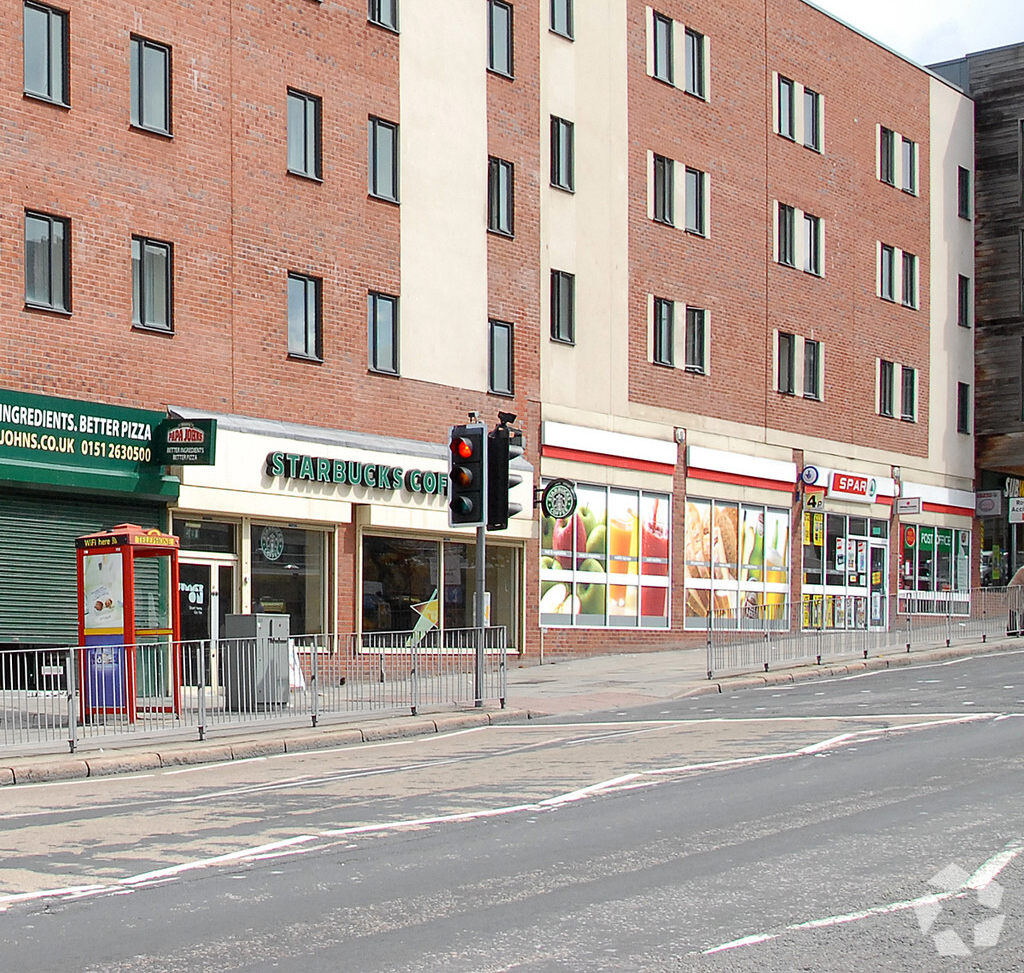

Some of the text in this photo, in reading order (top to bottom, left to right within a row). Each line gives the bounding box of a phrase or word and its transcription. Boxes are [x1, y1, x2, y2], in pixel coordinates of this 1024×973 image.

[79, 414, 120, 436] BETTER
[121, 421, 152, 441] PIZZA
[168, 429, 183, 442] PAPA
[81, 440, 106, 457] 0151
[108, 445, 151, 462] 2630500
[268, 451, 448, 495] STARBUCKS COF
[838, 477, 867, 492] SPAR
[1004, 477, 1024, 497] SUB
[135, 535, 174, 545] TELEPHONE
[921, 533, 933, 544] POST
[936, 534, 951, 546] OFFICE
